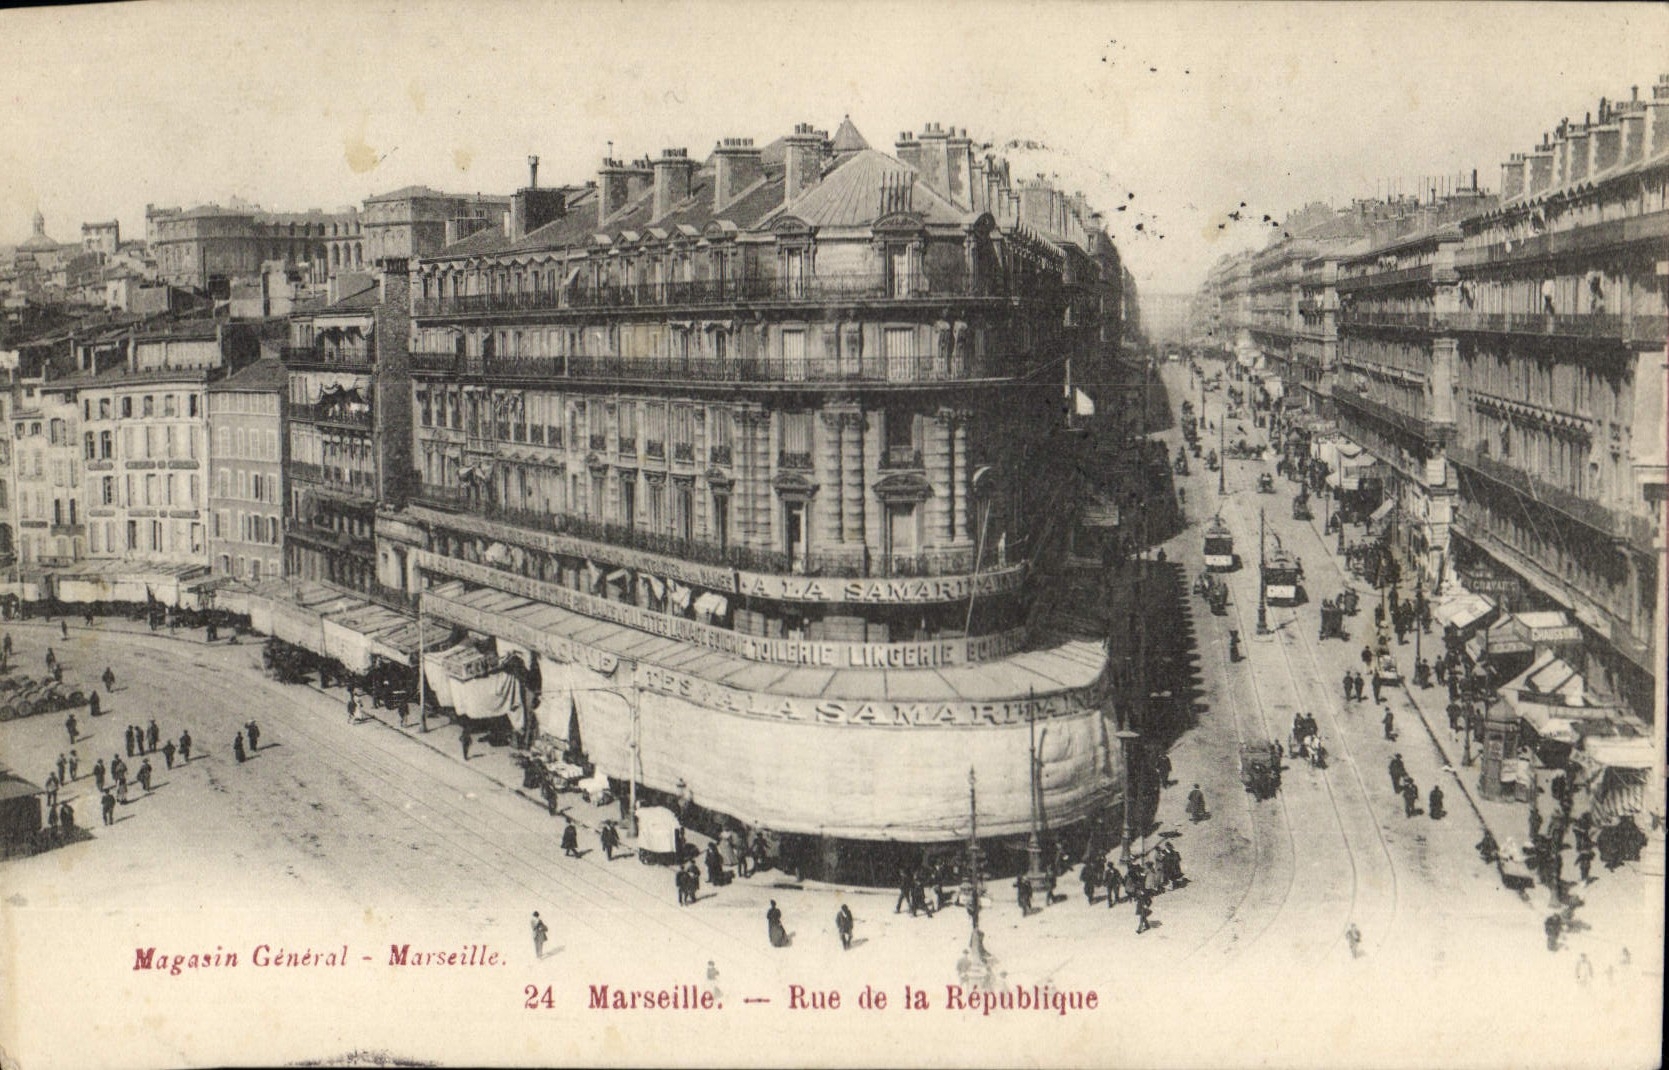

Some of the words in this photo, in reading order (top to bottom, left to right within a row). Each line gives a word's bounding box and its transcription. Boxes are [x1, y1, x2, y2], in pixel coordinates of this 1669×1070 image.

[751, 578, 770, 597] A
[781, 580, 831, 601] LA
[848, 643, 954, 668] LINGERIE
[746, 693, 801, 721] LA
[814, 685, 1101, 729] SAMARITAINE
